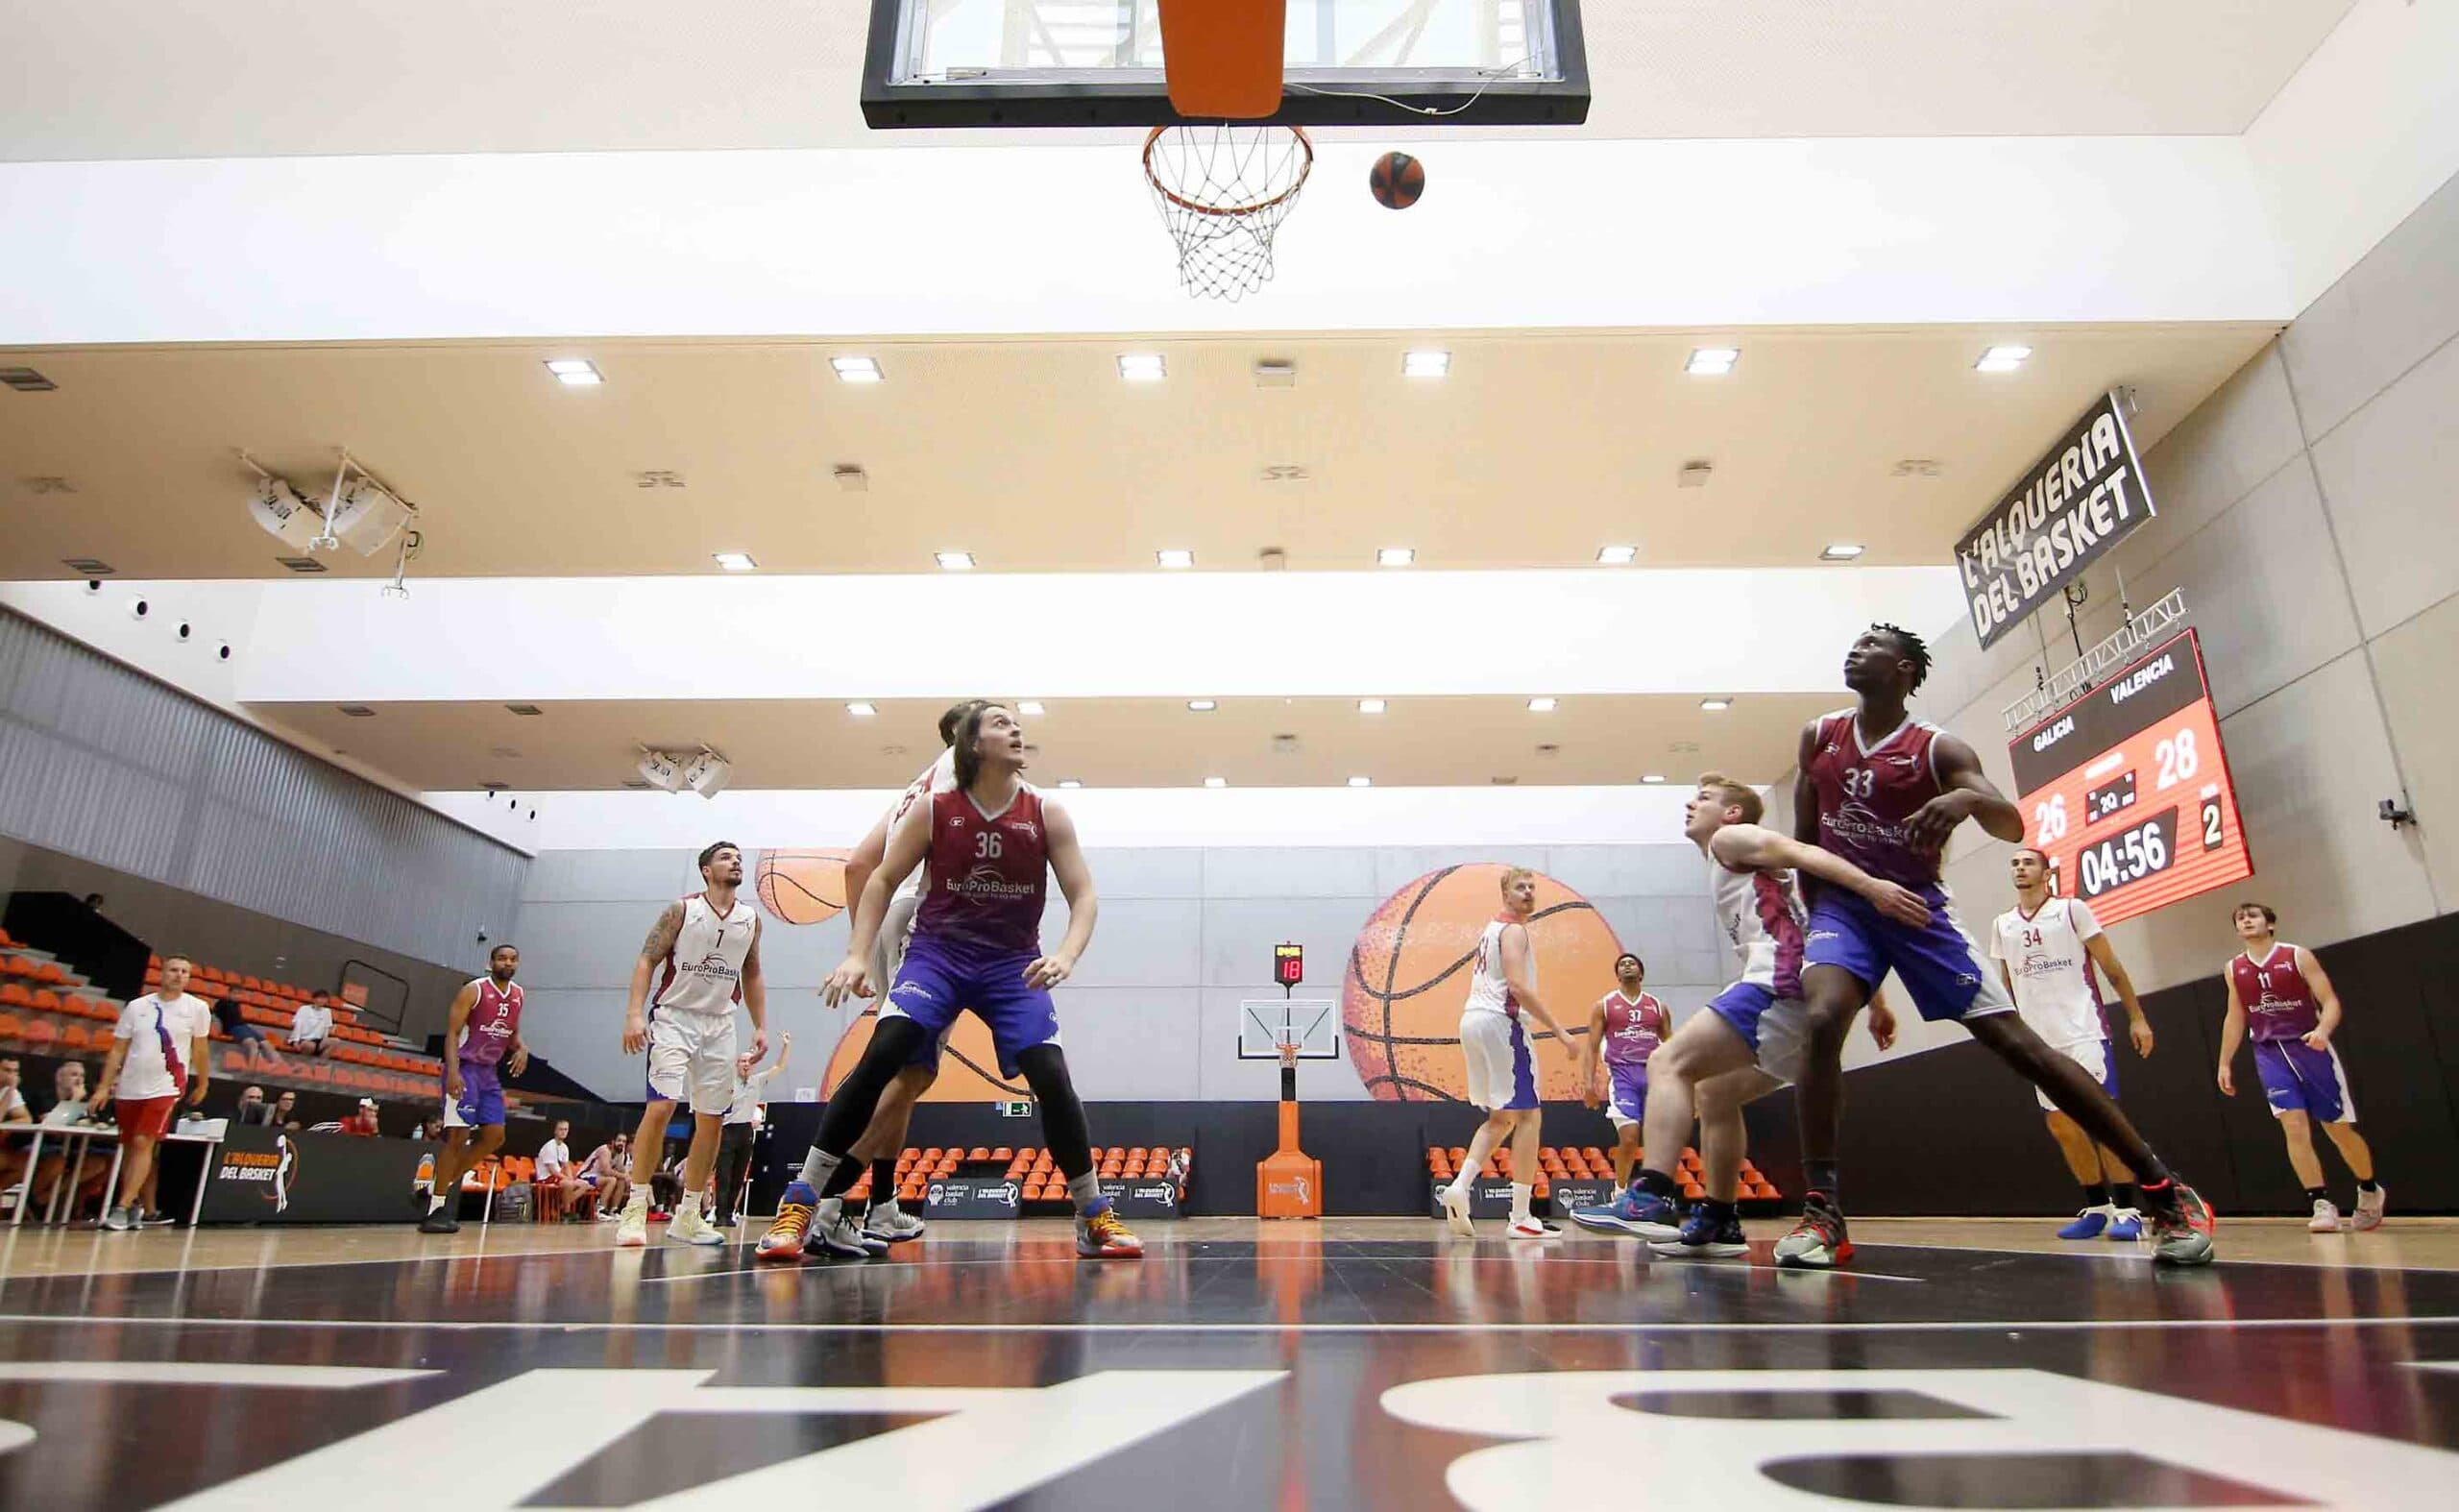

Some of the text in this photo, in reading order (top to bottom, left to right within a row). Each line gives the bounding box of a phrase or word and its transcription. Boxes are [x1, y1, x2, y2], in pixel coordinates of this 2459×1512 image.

[1961, 412, 2120, 589] L'ALQUERIA
[1973, 466, 2129, 638] DEL BASKET
[2110, 653, 2174, 704] VALENCIA
[2033, 716, 2075, 752] GALICIA
[2155, 728, 2198, 790] 28
[1844, 768, 1874, 797] 33
[2034, 793, 2066, 847] 26
[2203, 804, 2222, 845] 2
[975, 831, 1003, 859] 36
[2082, 822, 2167, 895] 04:56
[946, 878, 1035, 893] EuroProBasket
[718, 929, 724, 948] 7
[2023, 928, 2042, 948] 34
[1284, 961, 1301, 979] 18
[2257, 972, 2272, 988] 11
[1628, 1010, 1642, 1022] 37
[219, 1166, 277, 1181] DEL BASKET
